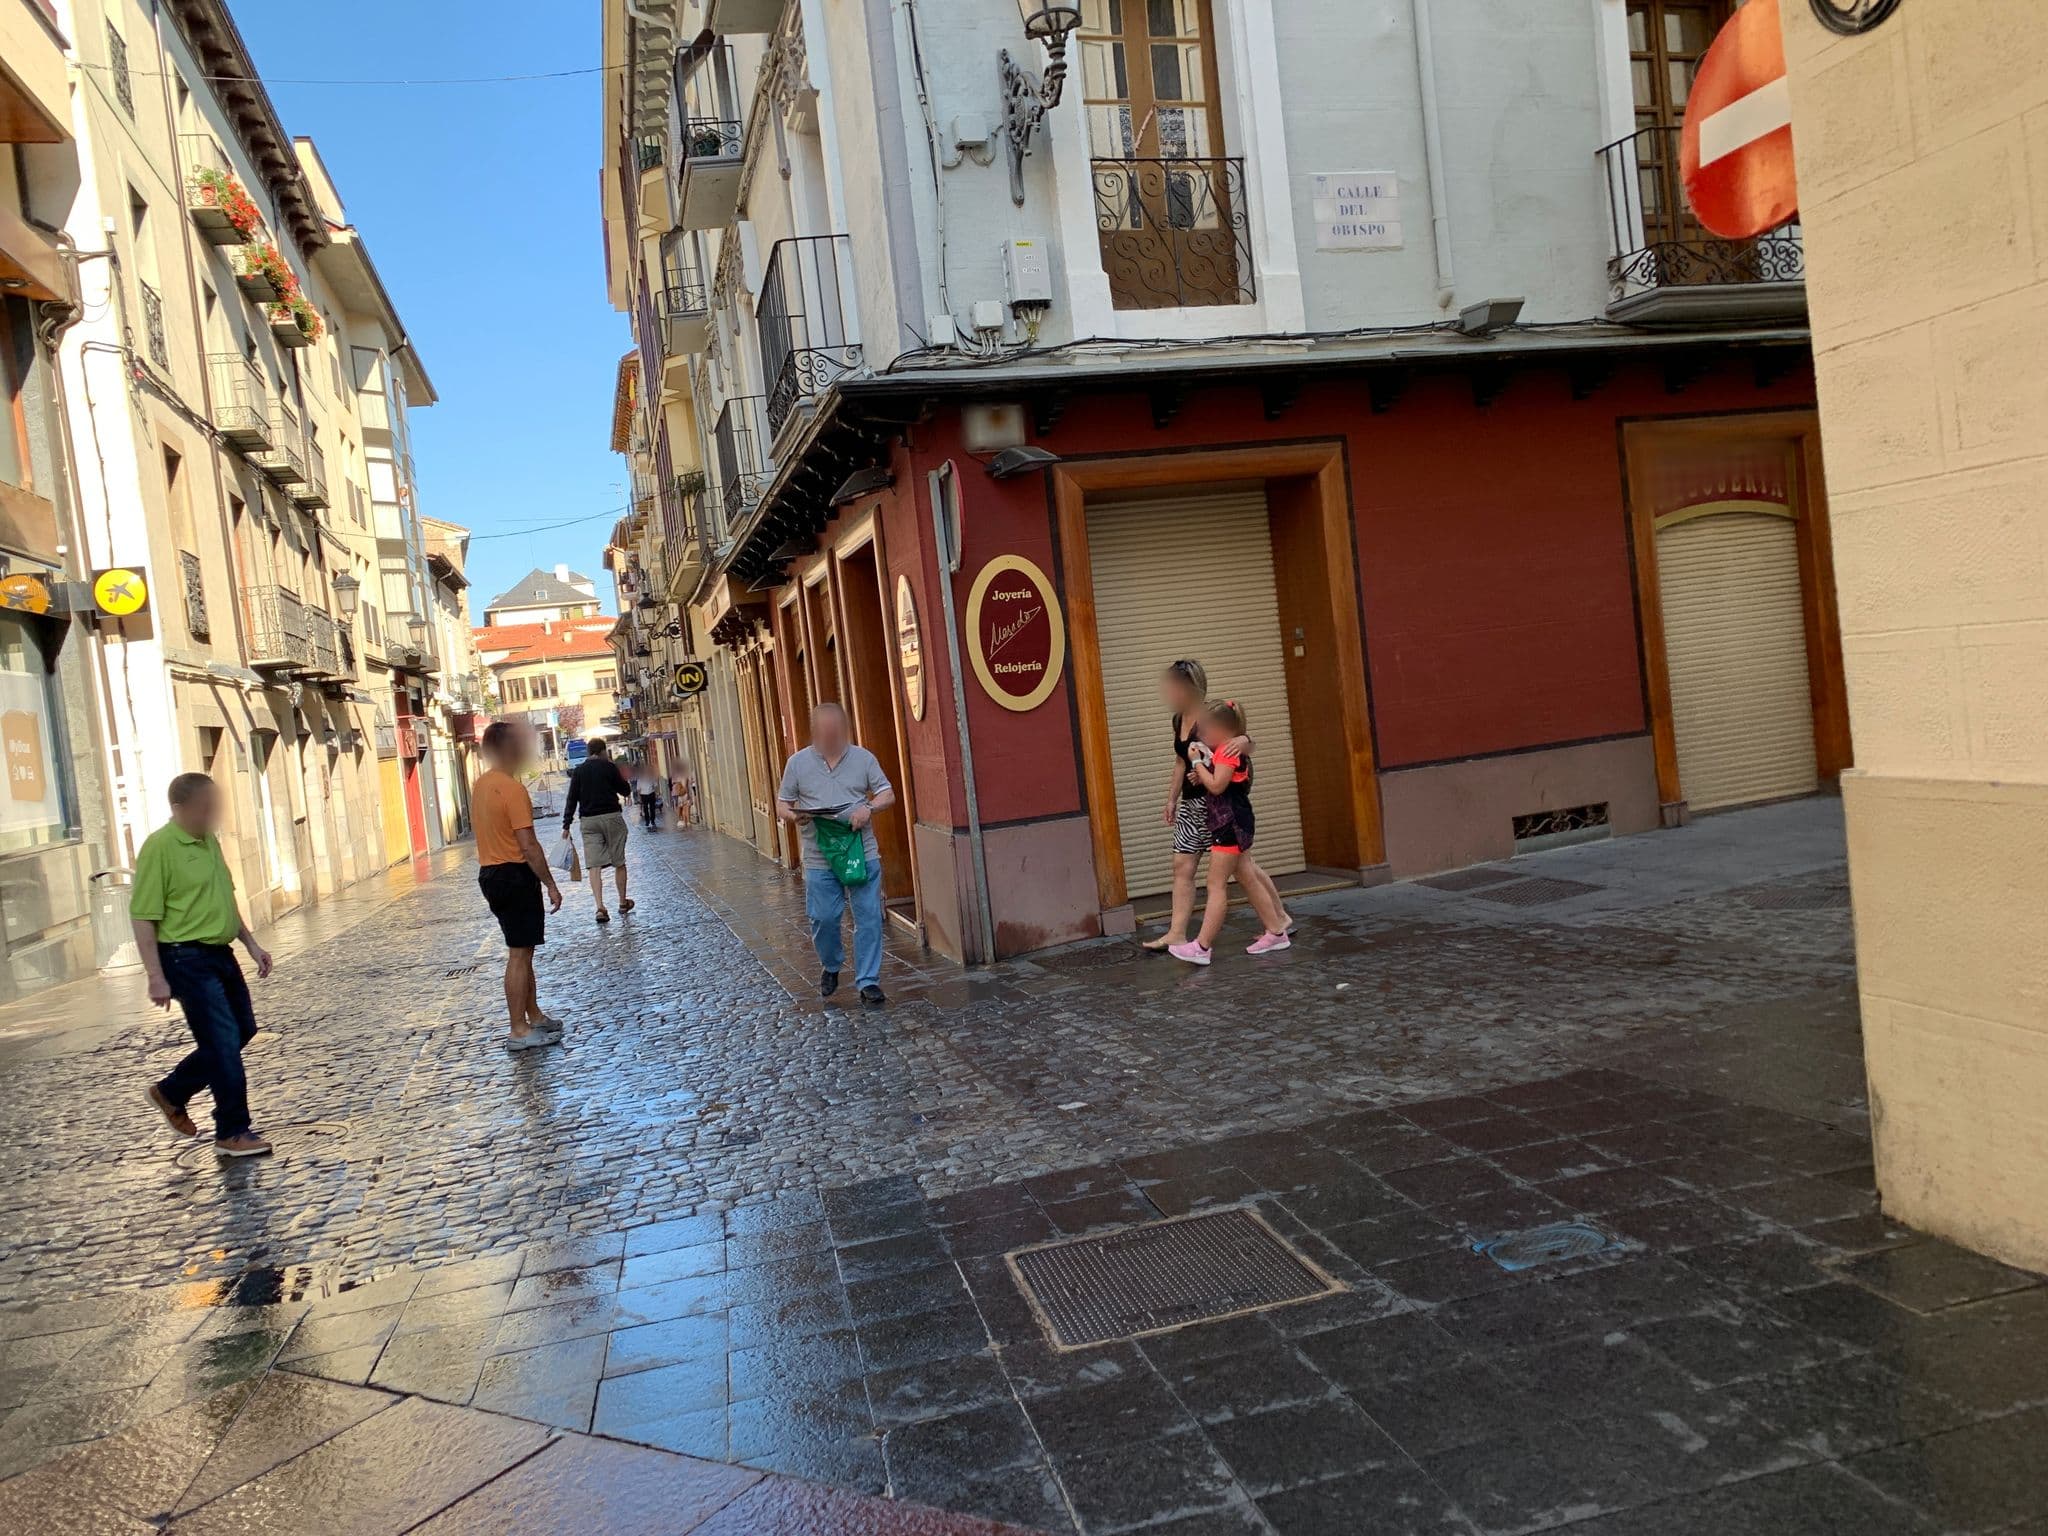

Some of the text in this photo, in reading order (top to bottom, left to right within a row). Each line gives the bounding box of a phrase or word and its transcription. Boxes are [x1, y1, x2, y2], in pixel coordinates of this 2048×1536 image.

[1337, 185, 1382, 199] CALLE
[1339, 204, 1367, 216] DEL
[1332, 223, 1385, 236] OBISPO
[991, 588, 1033, 602] Joyería
[994, 661, 1043, 675] Relojería
[681, 672, 700, 684] IN
